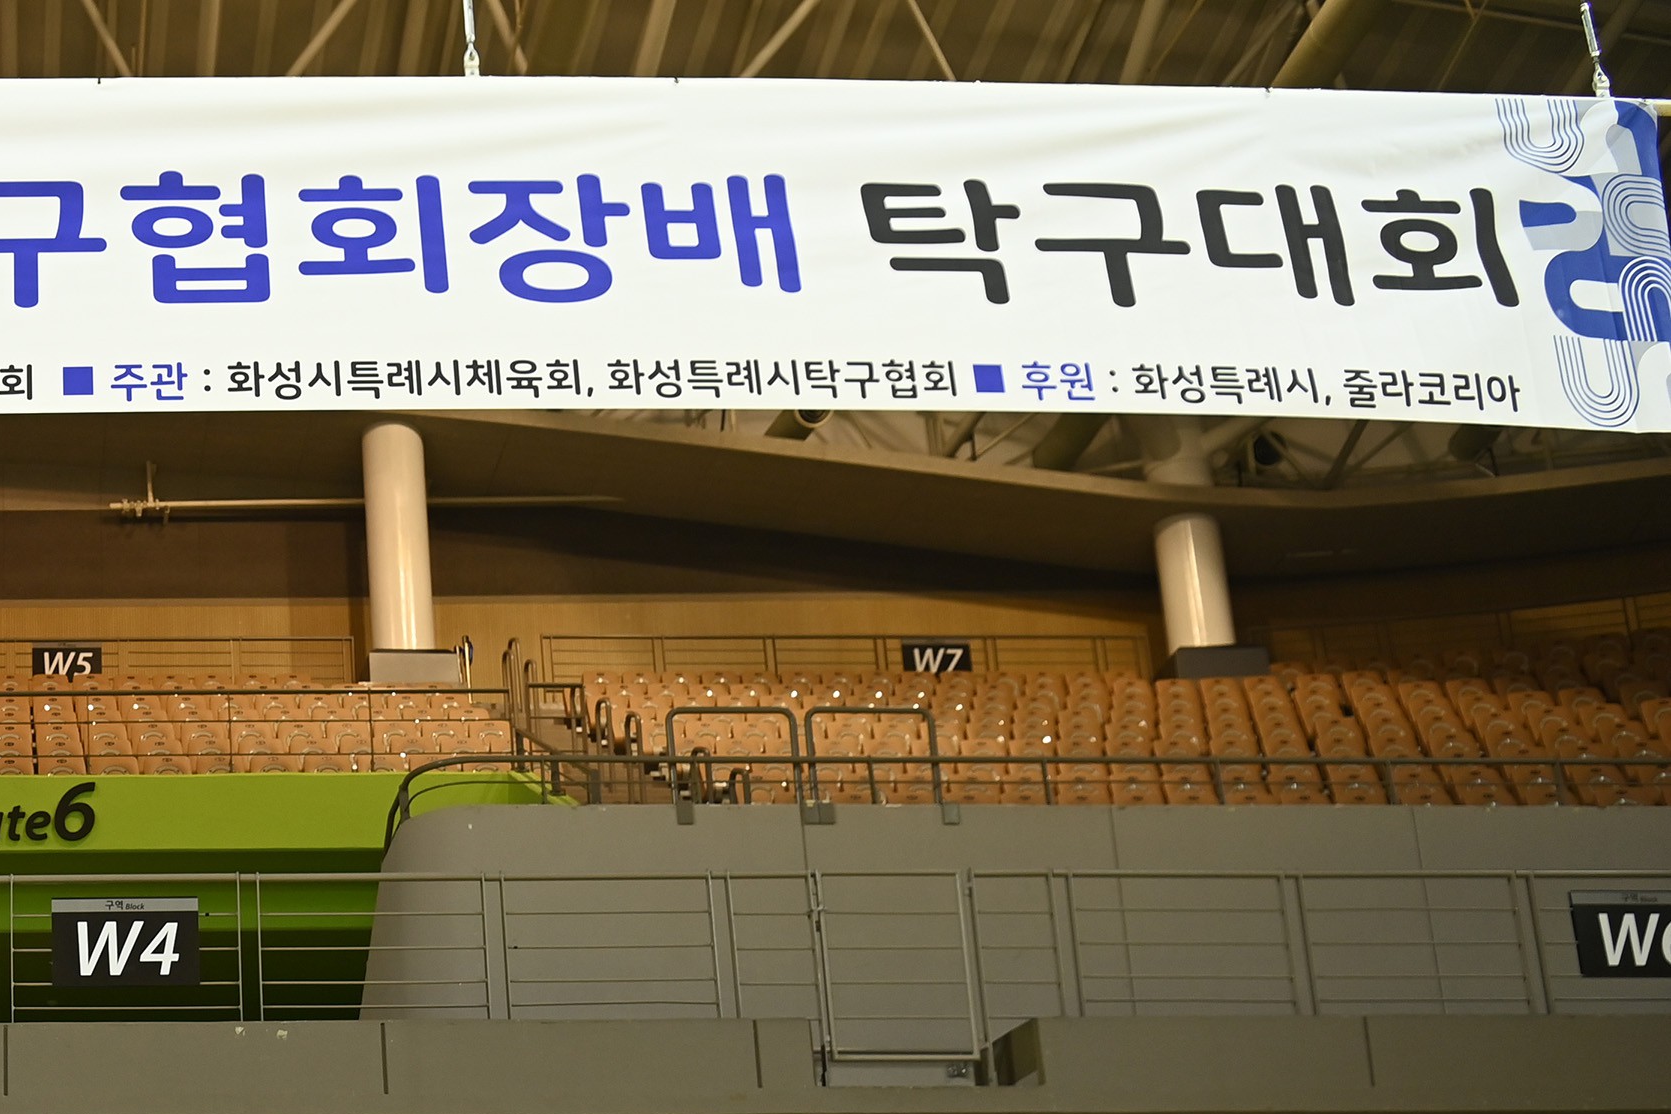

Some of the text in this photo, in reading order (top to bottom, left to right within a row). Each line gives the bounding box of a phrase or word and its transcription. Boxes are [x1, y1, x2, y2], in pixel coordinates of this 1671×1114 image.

[861, 180, 1522, 307] 탁구대회
[111, 362, 188, 402] 주관
[228, 359, 593, 400] 화성시특례시체육회,
[608, 359, 956, 399] 화성특례시탁구협회
[1023, 362, 1095, 401] 후원
[1132, 364, 1331, 406] 화성특례시,
[1344, 370, 1520, 412] 줄라코리아
[43, 651, 93, 676] W5
[913, 647, 964, 673] W7
[105, 901, 123, 910] 구역
[78, 921, 179, 976] W4
